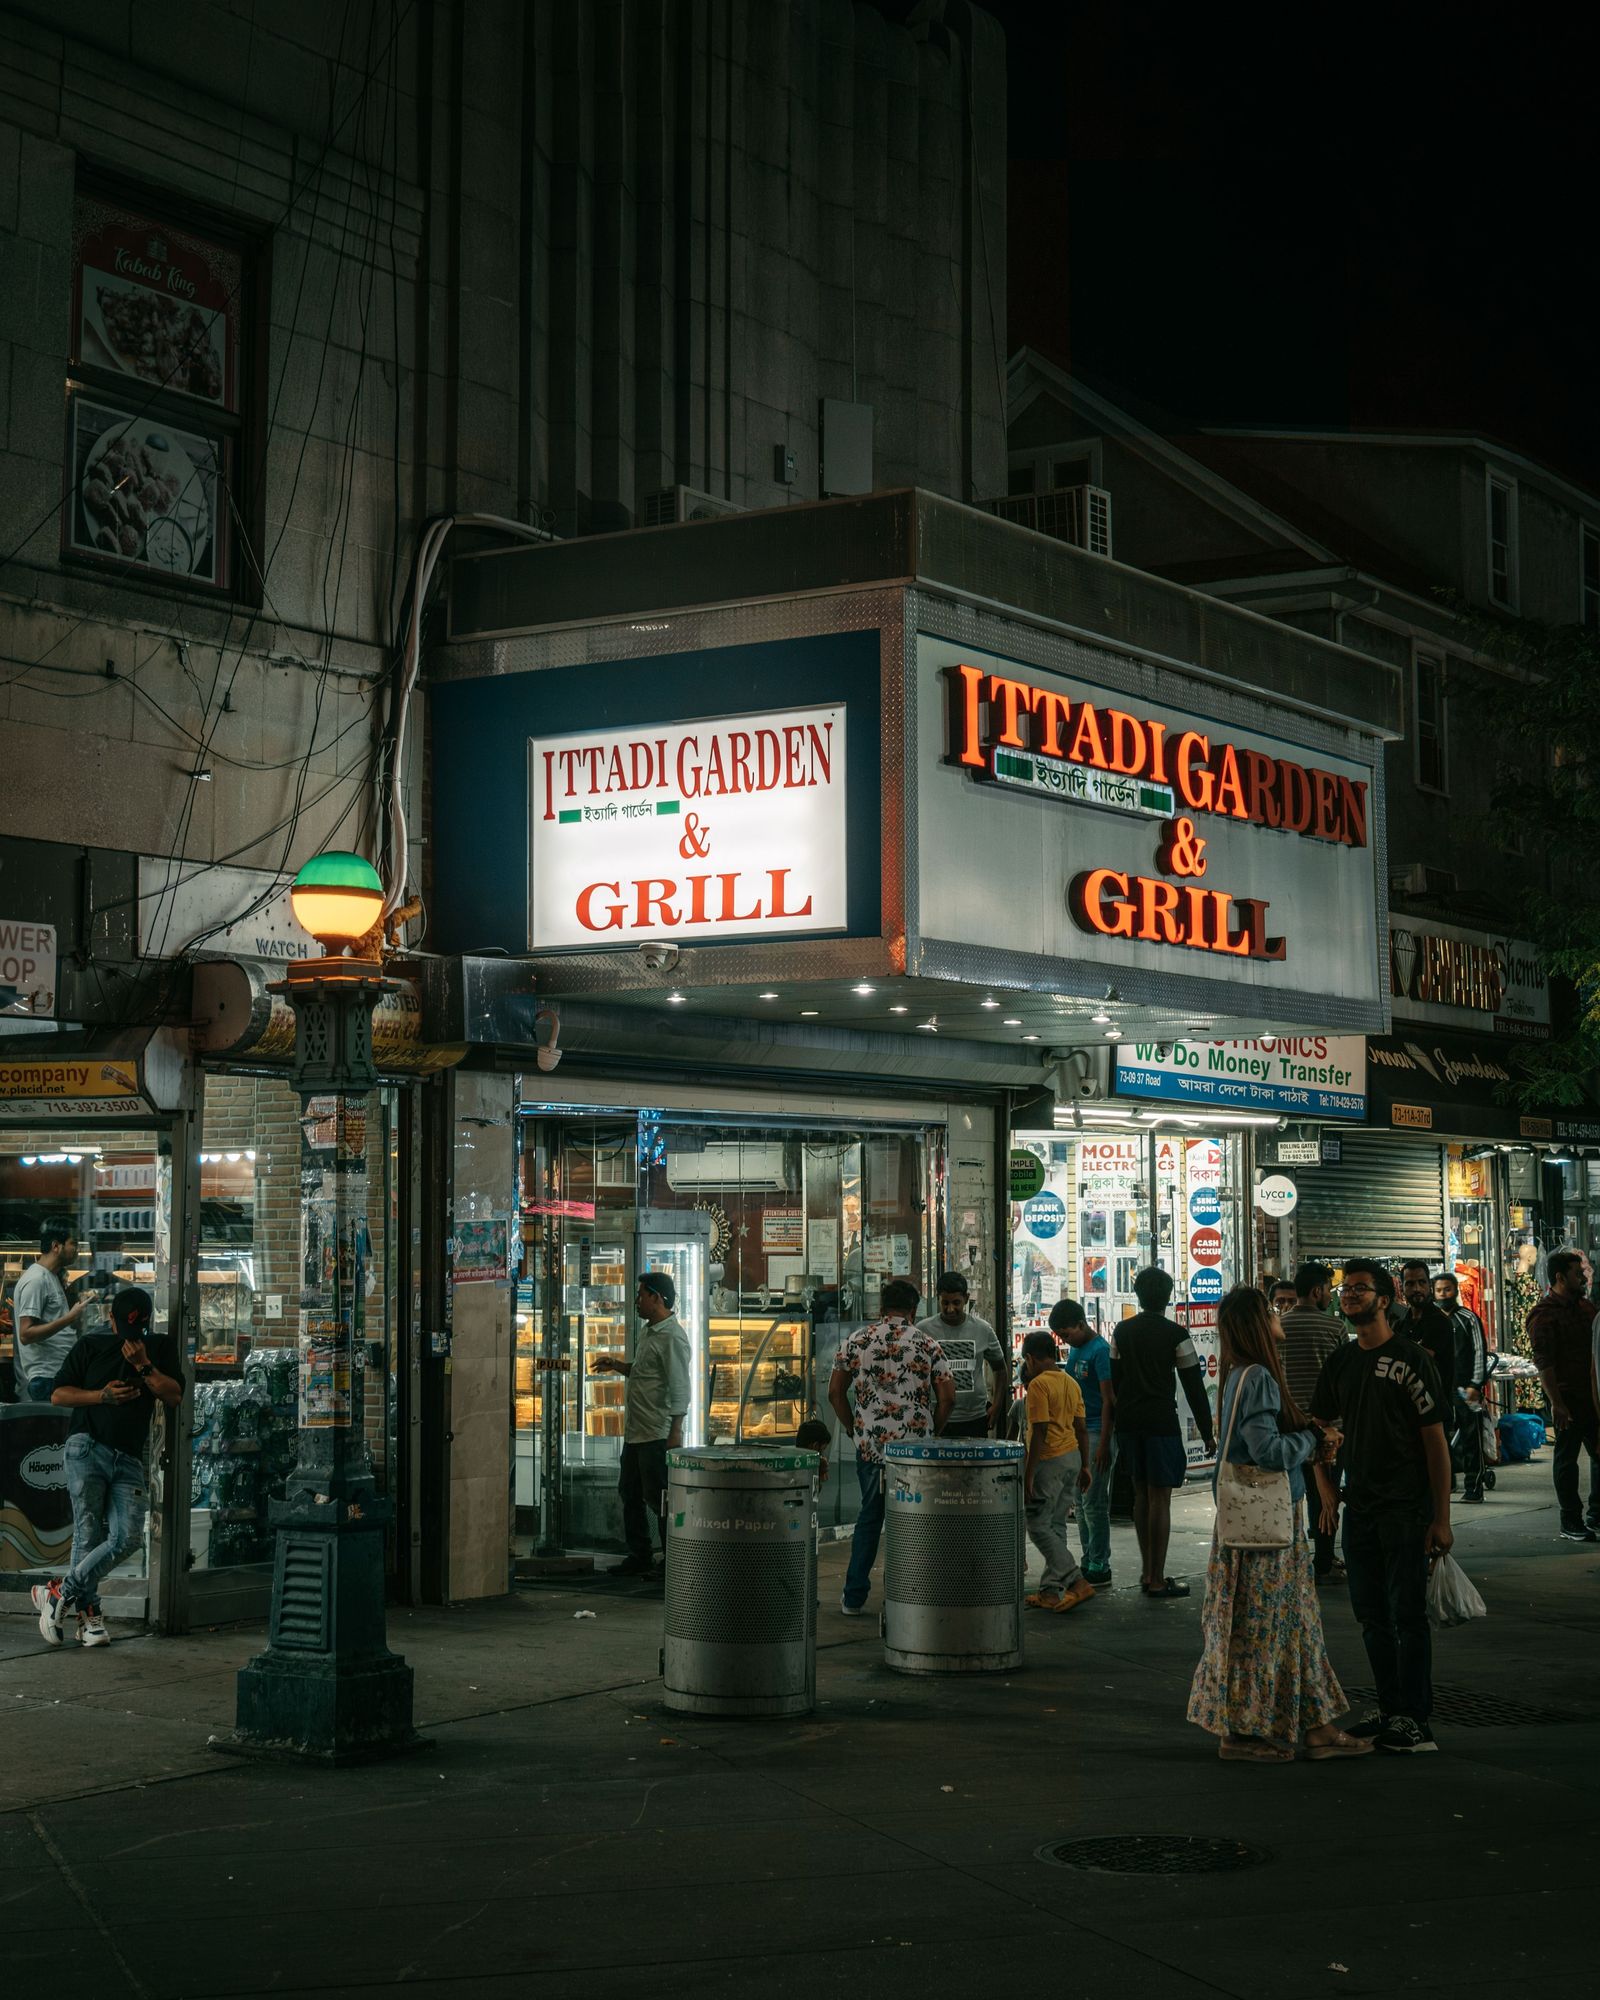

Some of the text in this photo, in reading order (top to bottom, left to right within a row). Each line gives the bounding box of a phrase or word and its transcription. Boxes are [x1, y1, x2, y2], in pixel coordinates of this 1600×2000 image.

[166, 265, 199, 299] King
[959, 664, 1367, 847] ITTADI GARDEN
[543, 722, 833, 821] ITTADI GARDEN
[1033, 758, 1137, 807] ইত্যাদি গার্ডেন
[583, 798, 653, 823] ইত্যাদি গার্ডেন
[679, 812, 710, 859] &
[1171, 817, 1207, 877] &
[575, 869, 812, 931] GRILL
[1084, 868, 1286, 961] GRILL
[255, 938, 308, 958] WATCH
[1173, 1043, 1200, 1068] Do
[1208, 1048, 1271, 1081] Money
[1279, 1058, 1352, 1086] Transfer
[0, 1068, 89, 1086] company
[1119, 1071, 1161, 1087] 73-09 37 Road
[1177, 1078, 1310, 1106] আমরা দেশে টাকা পাঠাই
[1318, 1094, 1328, 1106] Tel:
[44, 1101, 139, 1113] 718-392-3500
[1082, 1144, 1173, 1158] MOLLA
[1196, 1197, 1218, 1205] SEND
[1261, 1189, 1286, 1200] Lyca
[1031, 1204, 1059, 1212] BANK
[1025, 1214, 1065, 1222] DEPOSIT
[539, 1360, 568, 1369] PULL
[1375, 1355, 1435, 1416] SQUAD
[938, 1449, 985, 1458] Recycle
[29, 1460, 64, 1474] Häagen-
[692, 1518, 777, 1532] Mixed Paper
